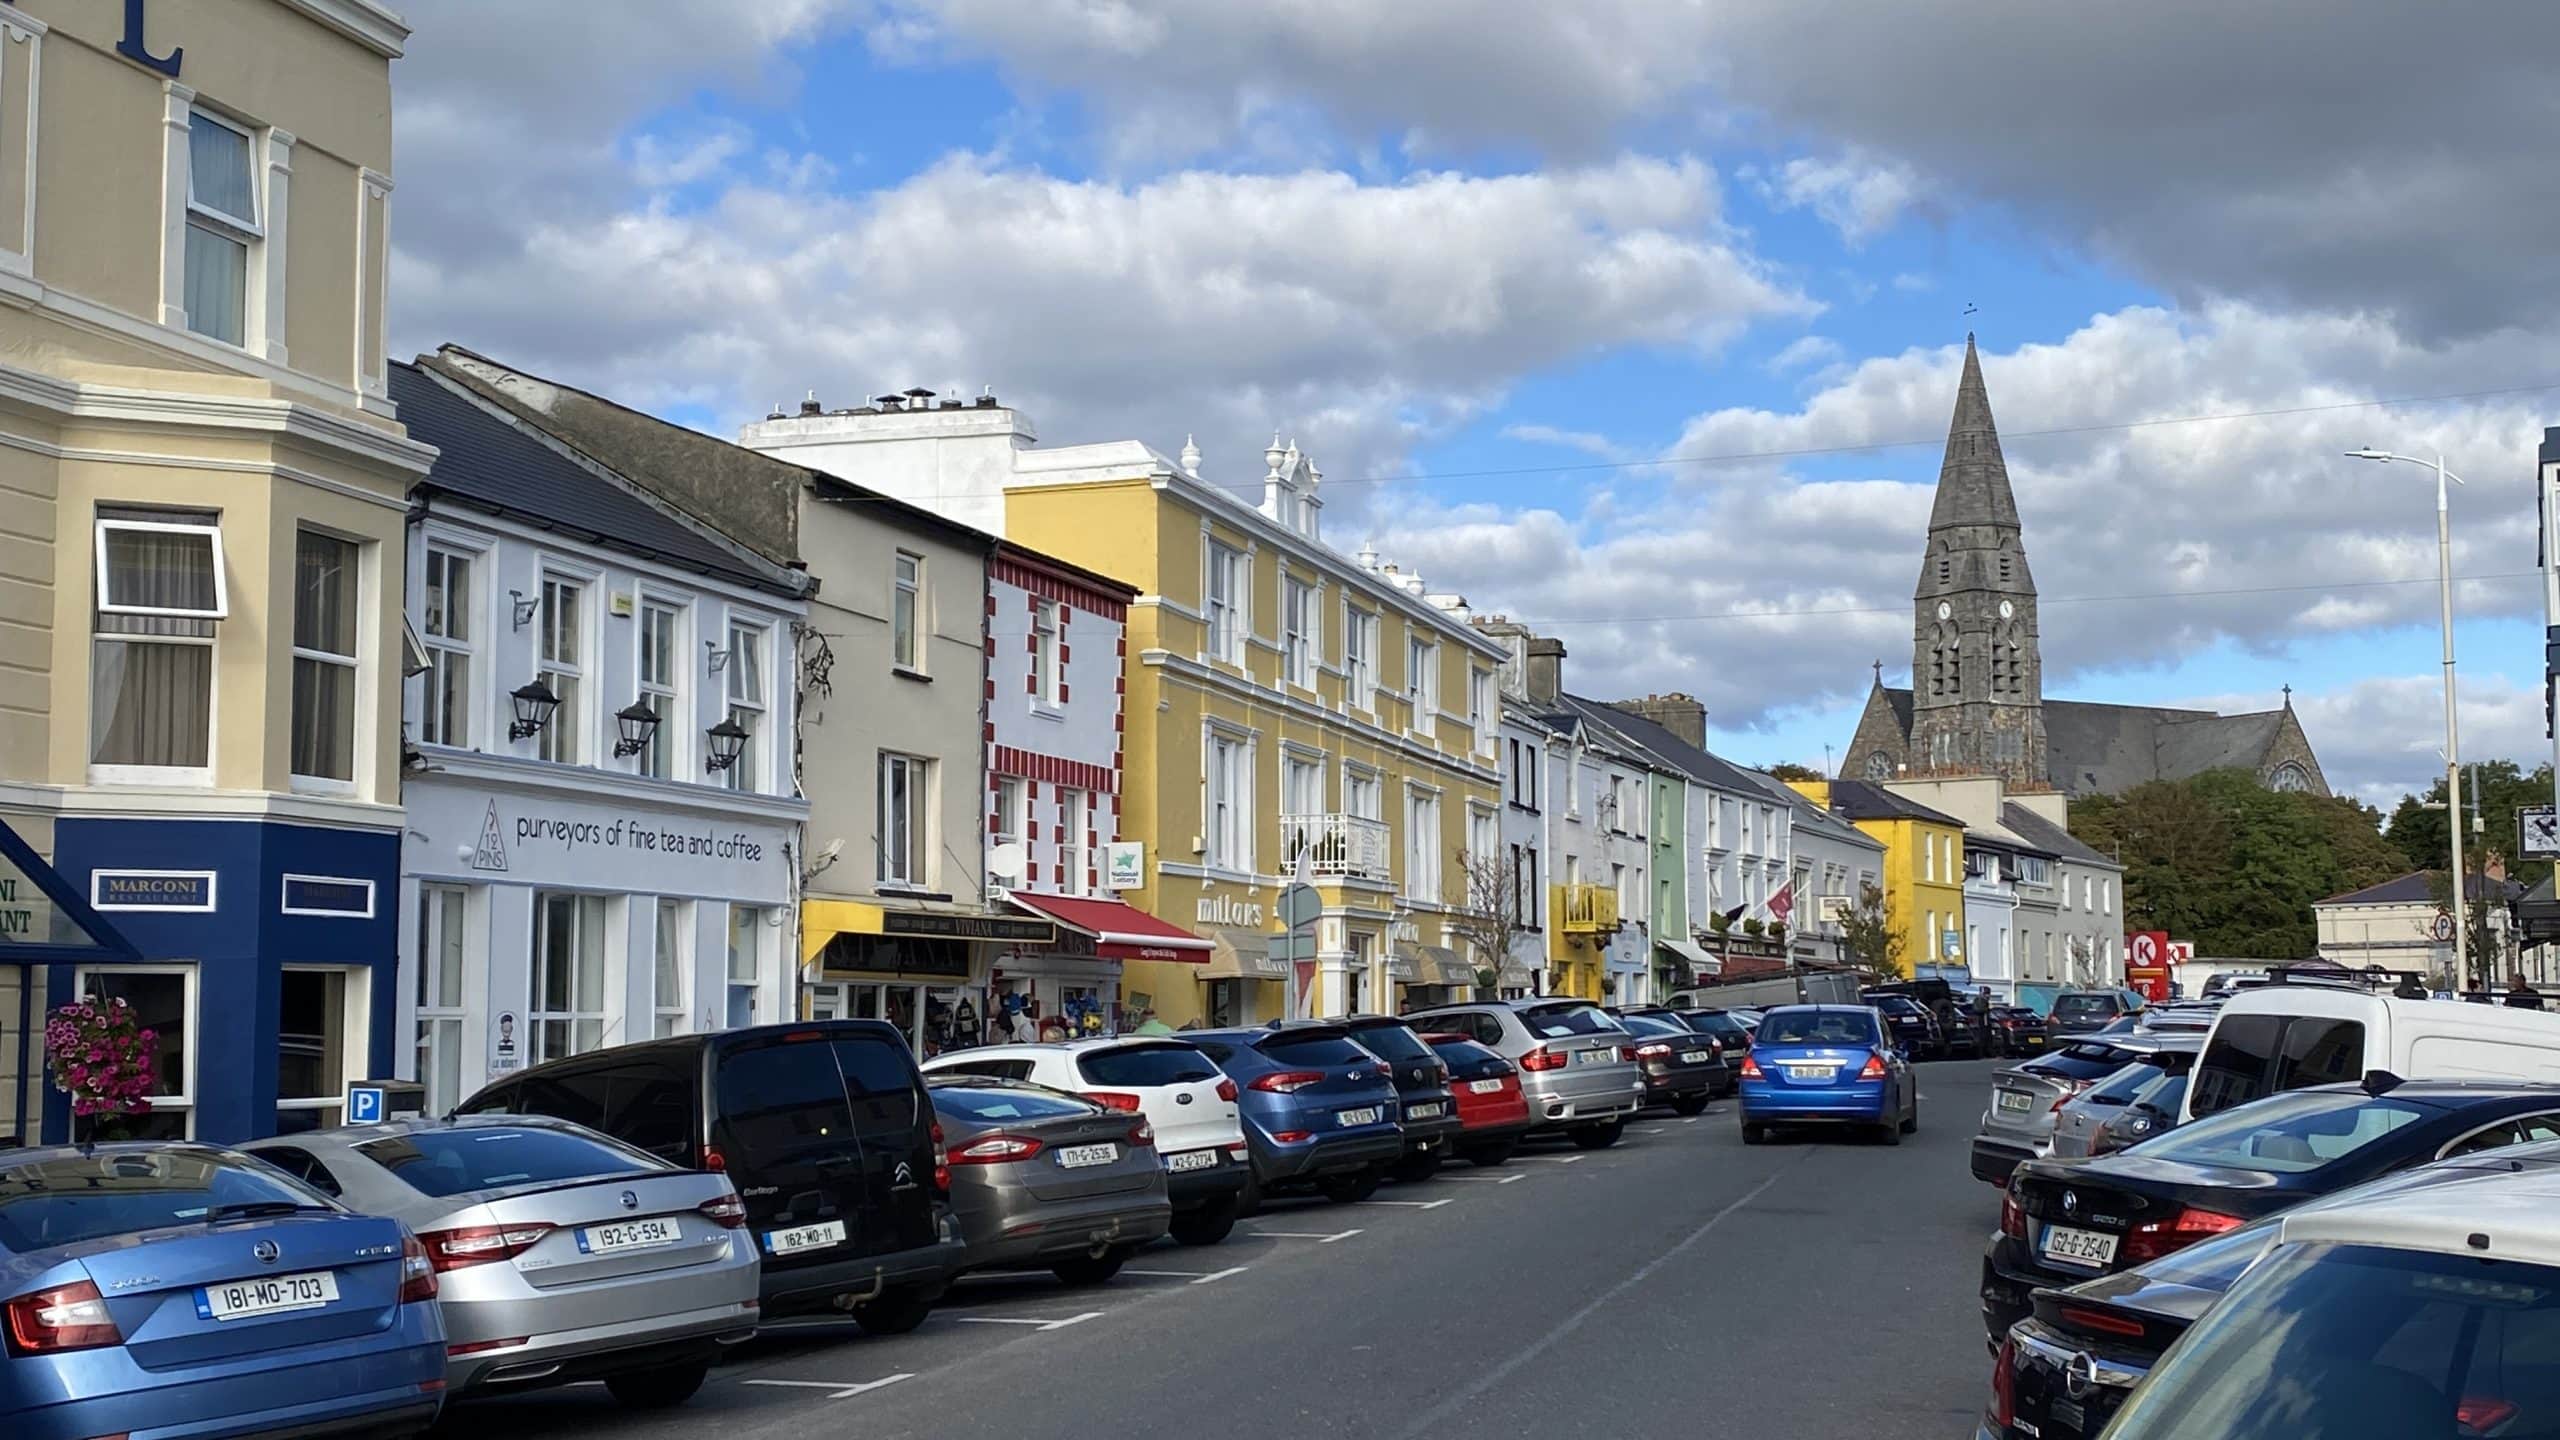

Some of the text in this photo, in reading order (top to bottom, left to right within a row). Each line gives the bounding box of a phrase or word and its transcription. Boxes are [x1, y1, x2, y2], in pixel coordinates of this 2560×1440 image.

[485, 832, 499, 850] 12
[517, 817, 762, 861] purveyors of fine tea and coffee
[479, 849, 503, 868] PINS
[109, 880, 197, 892] MARCONI
[955, 919, 993, 937] VIVIANA
[2440, 918, 2449, 937] P
[2138, 942, 2152, 962] K
[357, 1093, 374, 1118] P
[600, 1222, 668, 1247] 192-G-594
[784, 1227, 833, 1247] 162-MO-11
[223, 1278, 322, 1310] 181-MO-703
